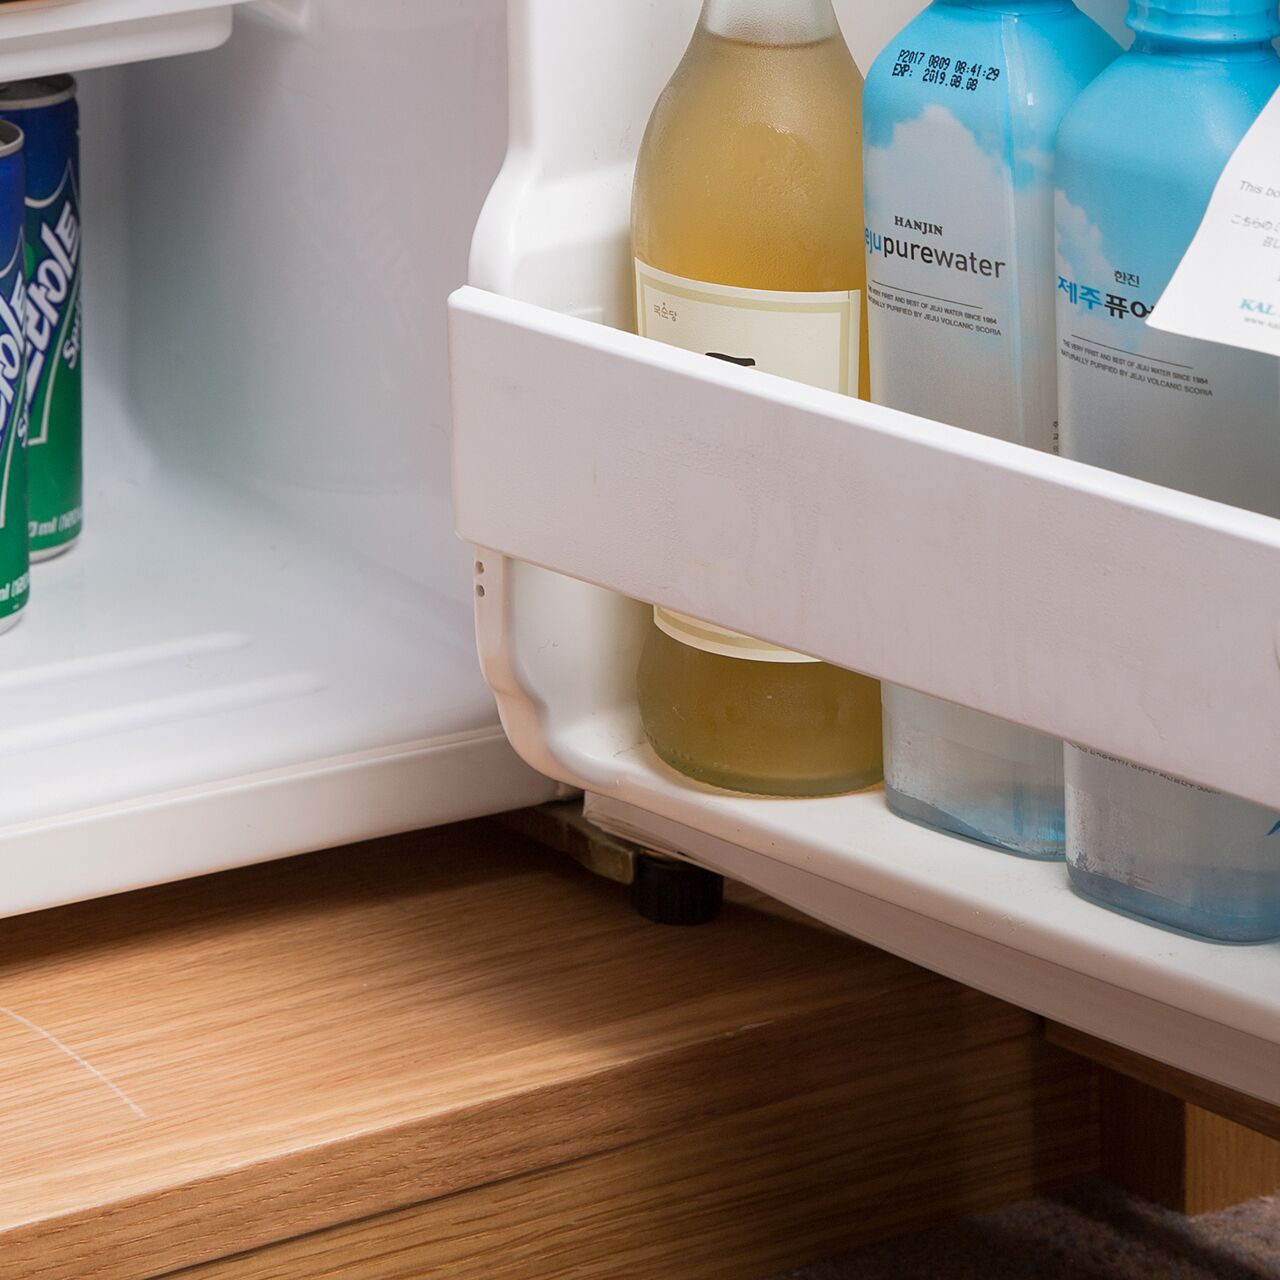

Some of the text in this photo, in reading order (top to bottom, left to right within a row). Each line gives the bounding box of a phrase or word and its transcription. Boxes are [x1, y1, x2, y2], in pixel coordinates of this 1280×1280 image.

[892, 63, 978, 91] EXP: 2019.08.08
[929, 55, 950, 70] 0809
[955, 60, 999, 80] 08:41:29
[1240, 181, 1263, 194] This
[894, 216, 942, 236] HANJIN
[865, 228, 1006, 278] ejupurewater
[1115, 270, 1139, 288] 한진
[1058, 276, 1154, 319] 제주퓨어
[1240, 298, 1275, 315] KAL
[654, 302, 677, 321] 국순당
[887, 304, 912, 316] PURIFIED
[914, 310, 922, 318] BY
[924, 314, 939, 322] JEJU
[941, 318, 974, 330] VOLCANIC
